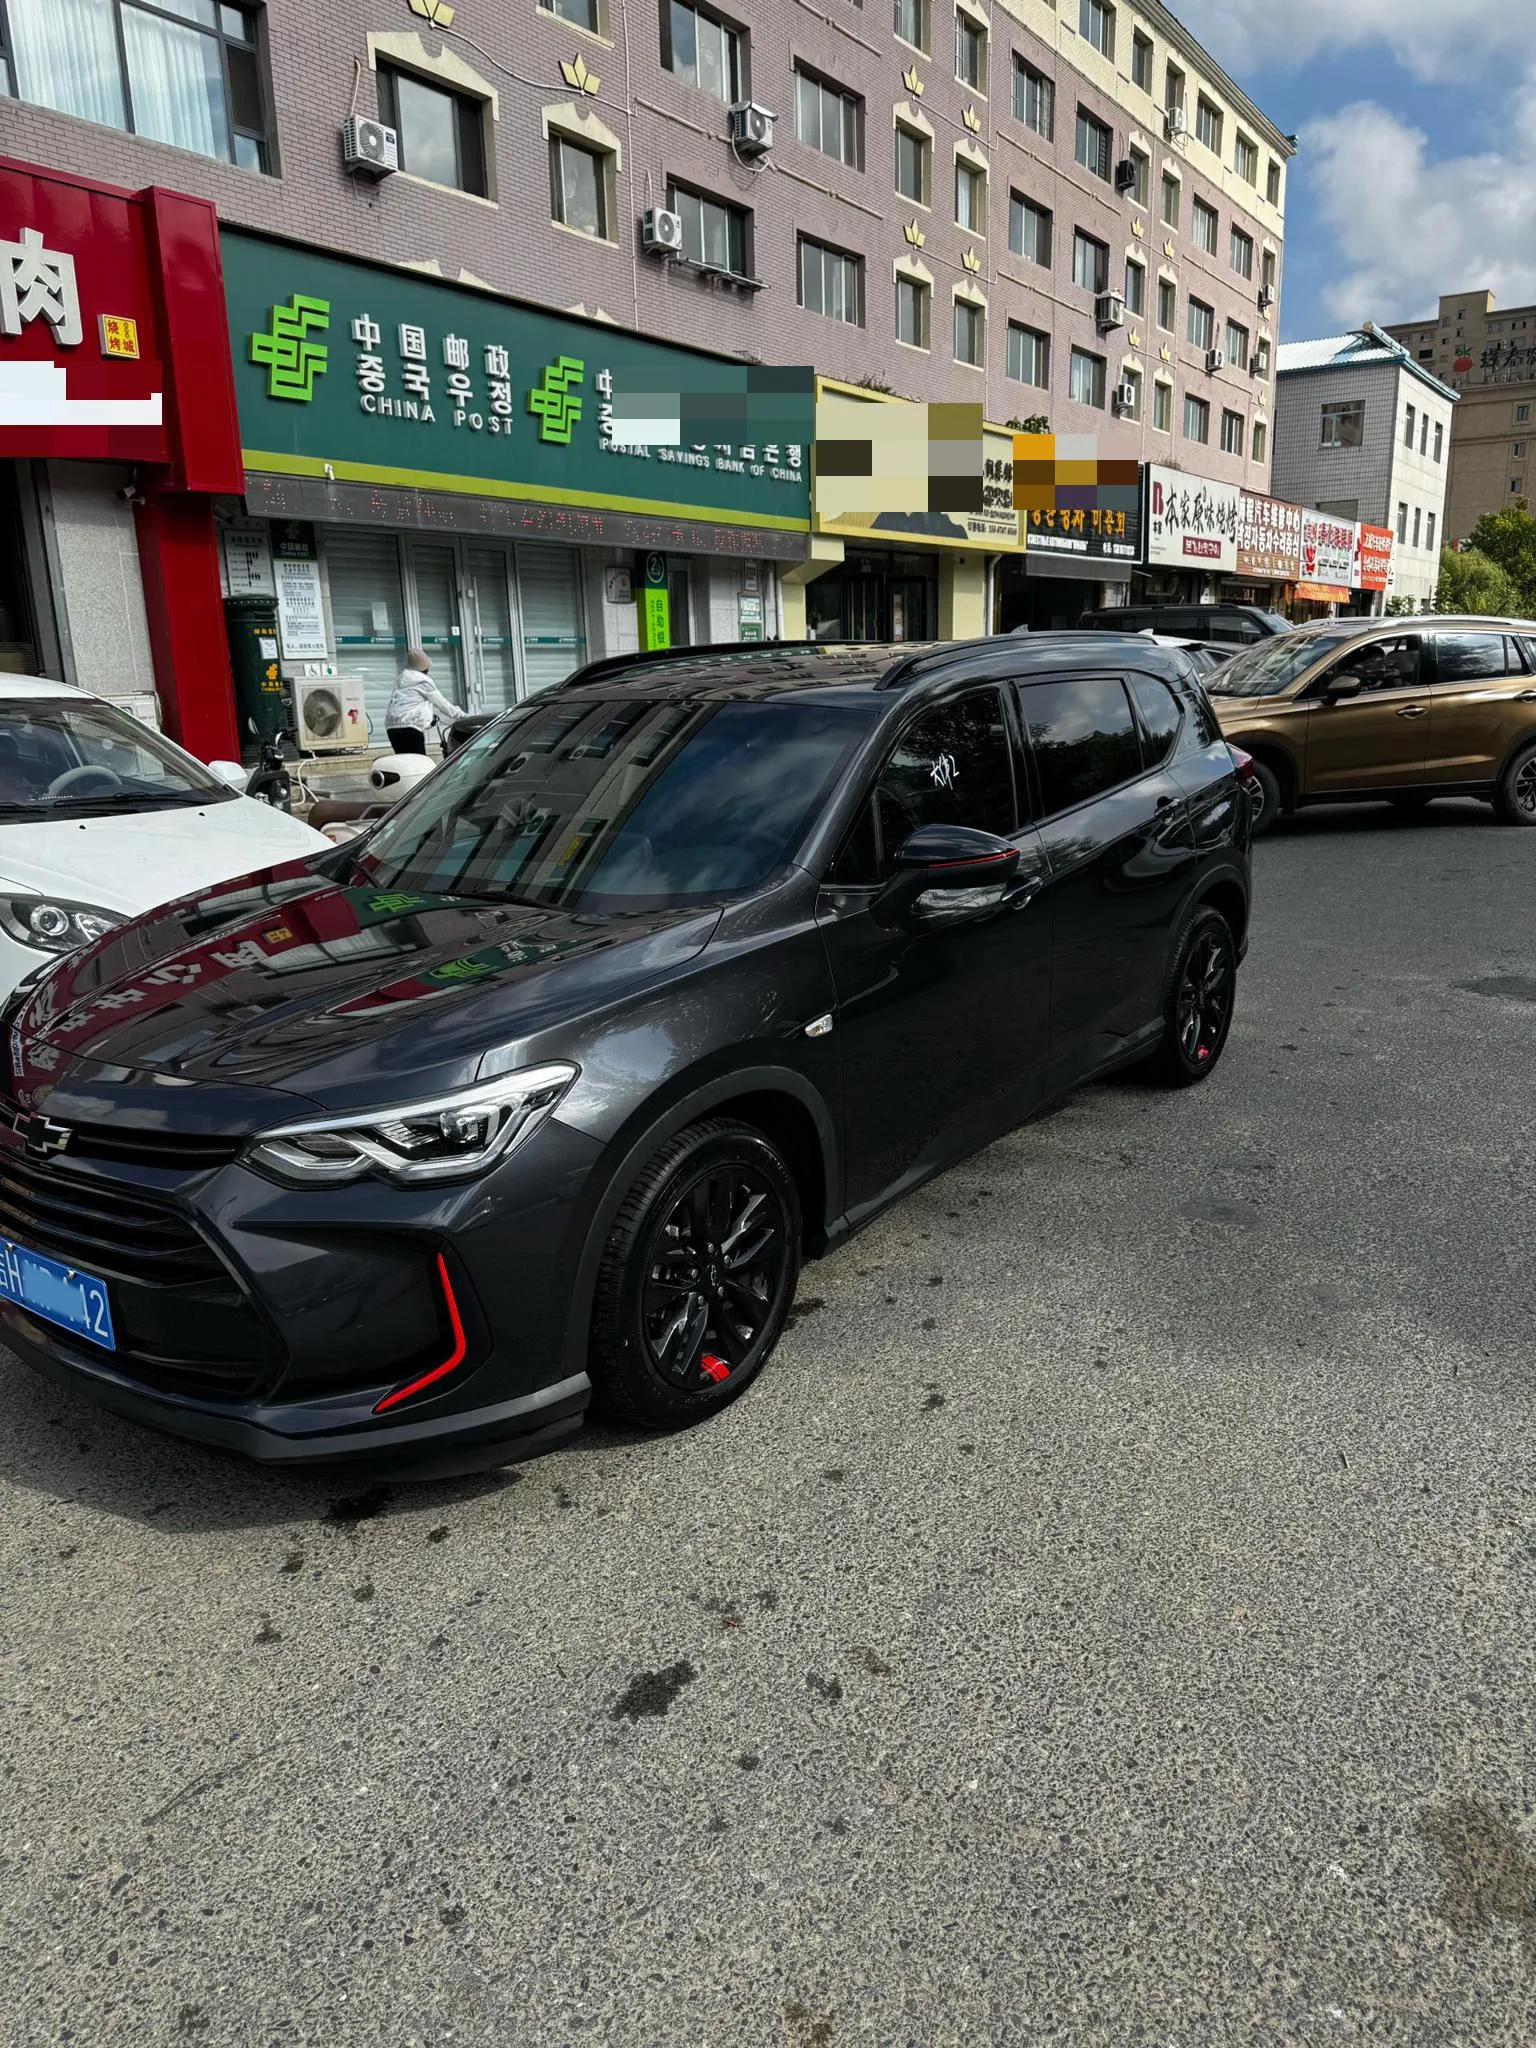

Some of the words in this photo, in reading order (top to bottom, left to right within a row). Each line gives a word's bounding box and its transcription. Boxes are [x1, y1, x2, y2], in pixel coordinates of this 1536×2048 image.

[0, 227, 83, 346] 肉
[351, 313, 510, 379] 中国邮政
[355, 353, 513, 415] 중국우정
[360, 394, 436, 422] CHINA
[453, 409, 513, 434] POST
[658, 448, 710, 468] SAVINGS
[715, 457, 745, 473] BANK
[750, 464, 765, 476] OF
[769, 467, 803, 482] CHINA
